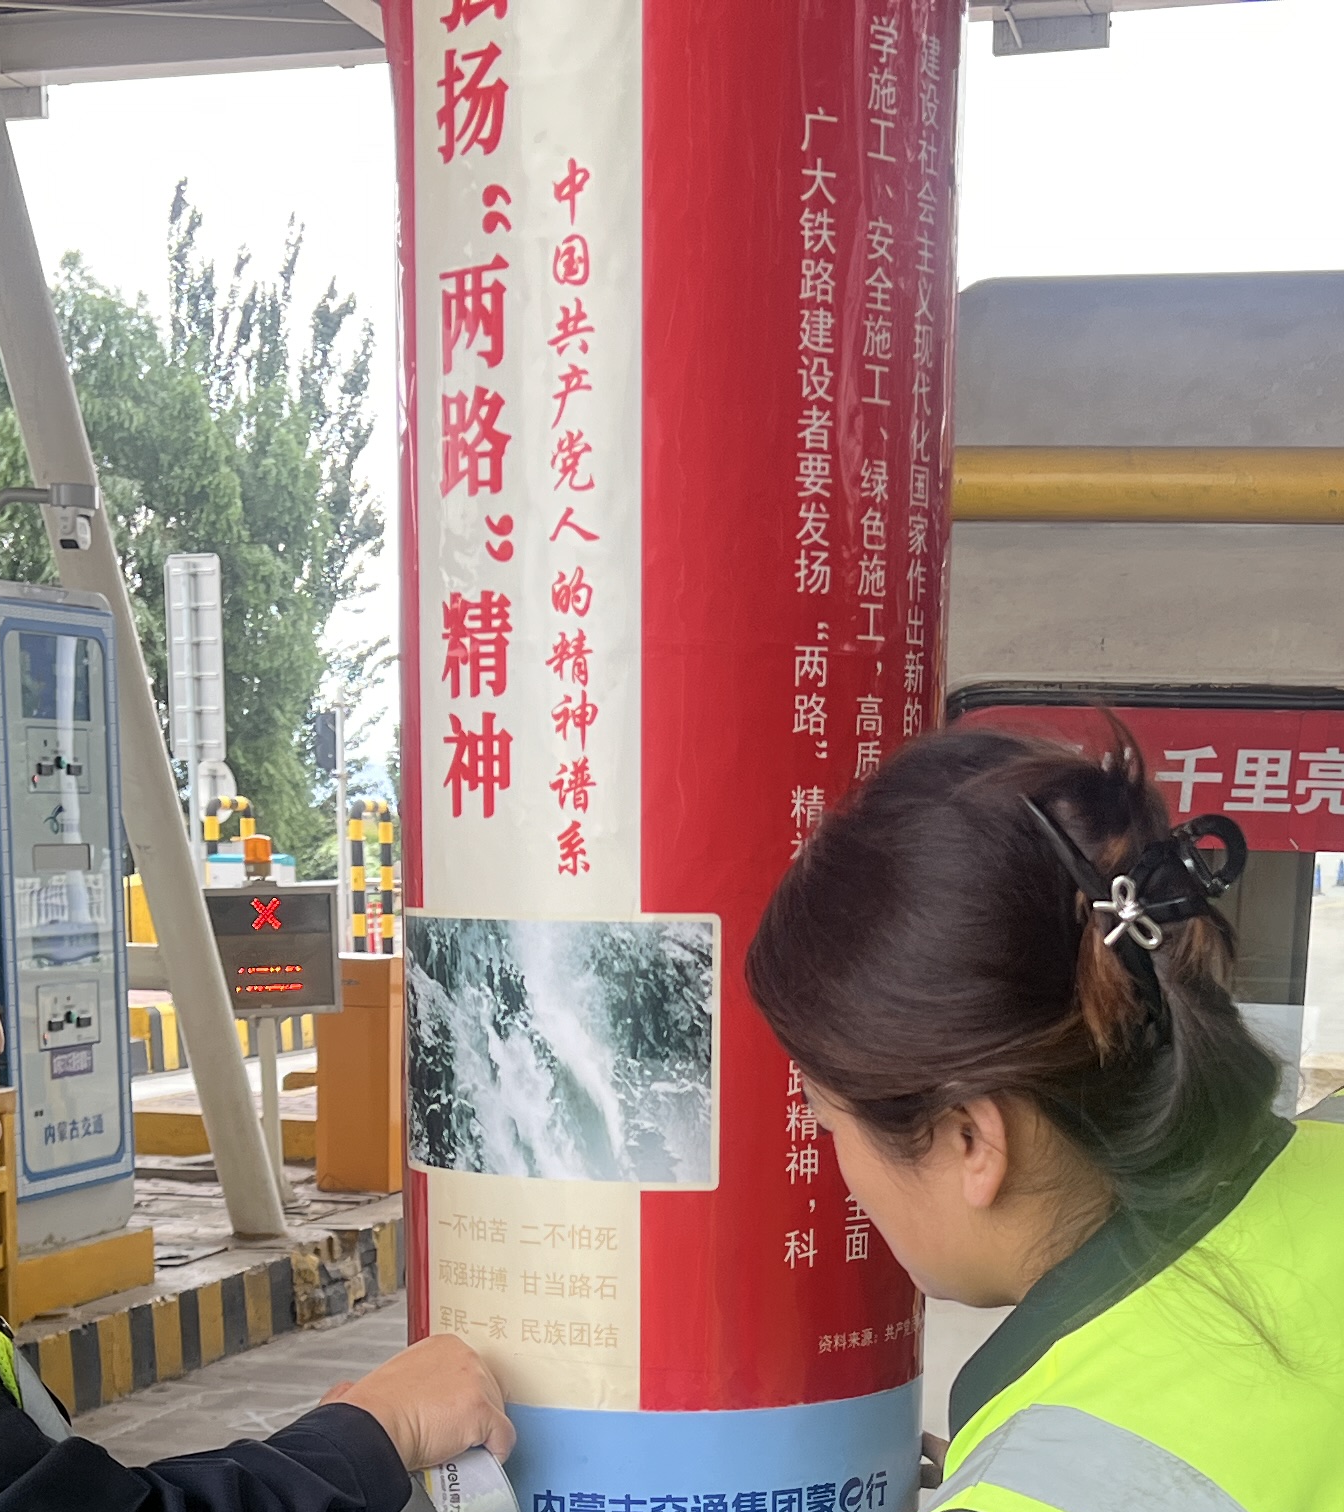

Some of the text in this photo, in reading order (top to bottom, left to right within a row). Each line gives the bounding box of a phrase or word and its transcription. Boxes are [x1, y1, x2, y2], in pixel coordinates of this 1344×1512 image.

[436, 0, 512, 818] 扬“两路”精神
[546, 157, 600, 876] 中国共产党人的精神谱系
[44, 1113, 105, 1146] 内蒙古交通
[438, 1214, 618, 1251] 一不怕苦 二不怕死
[438, 1259, 618, 1301] 顽强拼搏 甘当路石
[439, 1305, 619, 1349] 军民一家 民族团结
